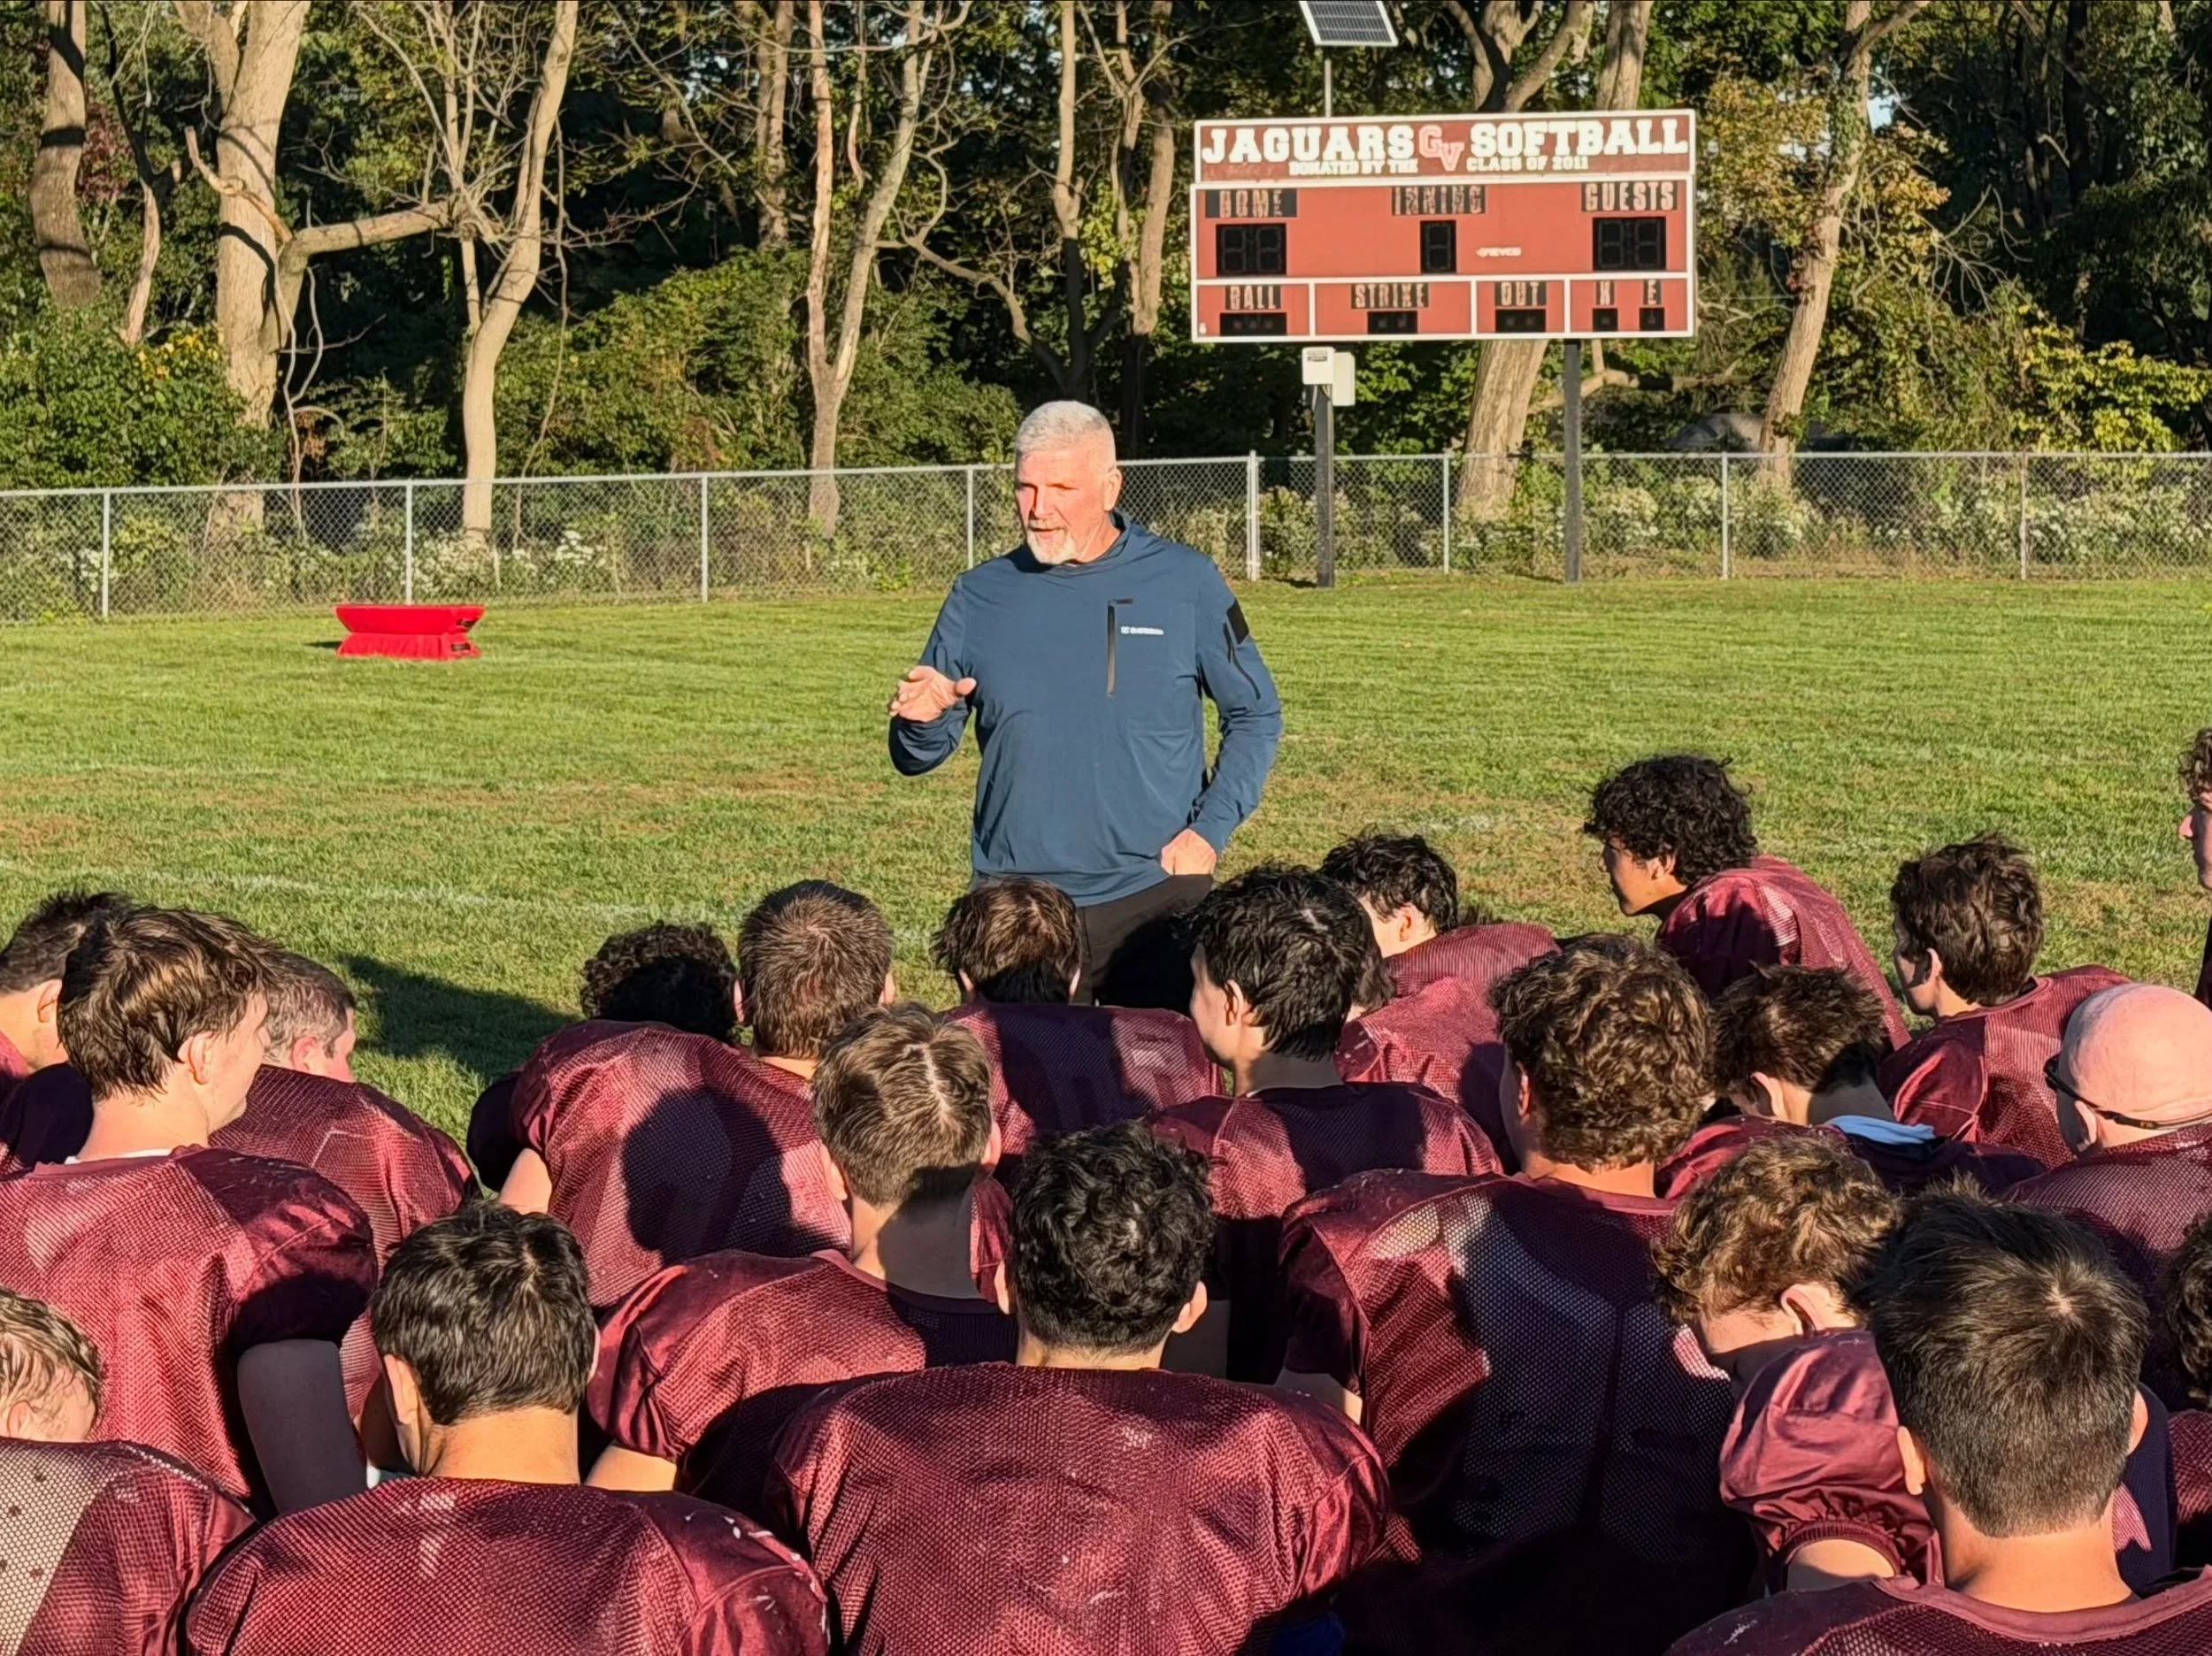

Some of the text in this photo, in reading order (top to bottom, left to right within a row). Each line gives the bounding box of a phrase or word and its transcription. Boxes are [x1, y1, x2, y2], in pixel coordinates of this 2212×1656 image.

[1202, 125, 1415, 164] JAGUARS
[1470, 119, 1688, 157] SOFTBALL
[1288, 156, 1589, 176] DONATED BY THE CLASS OF 2011
[1219, 189, 1283, 218] HOME
[1585, 181, 1675, 212] GUESTS
[1229, 285, 1276, 310] BALL
[1355, 283, 1425, 309] STRIKE
[1501, 281, 1540, 306] OUT
[1647, 280, 1657, 305] E
